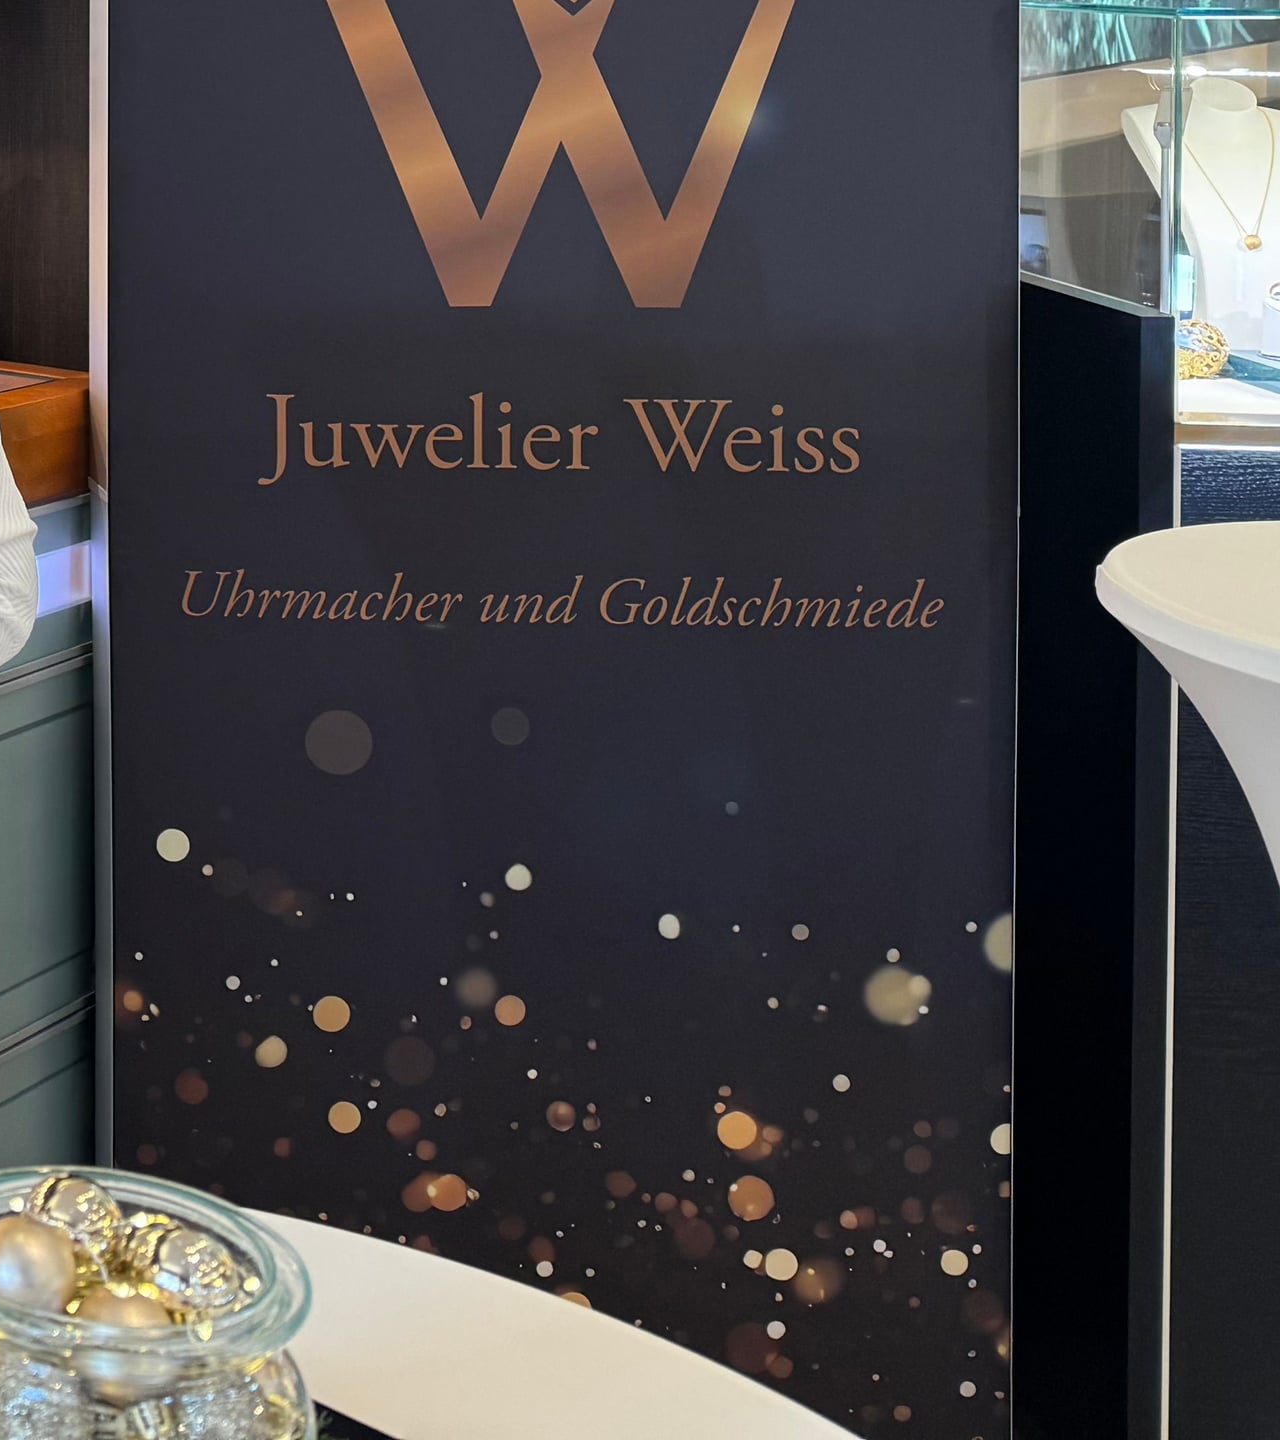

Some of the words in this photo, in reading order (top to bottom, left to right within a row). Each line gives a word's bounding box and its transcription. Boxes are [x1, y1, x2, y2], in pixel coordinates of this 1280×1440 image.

[258, 390, 600, 486] Juwelier
[623, 396, 863, 476] Weiss
[178, 568, 464, 628] Uhrmacher
[479, 572, 584, 627] und
[598, 574, 947, 631] Goldschmiede
